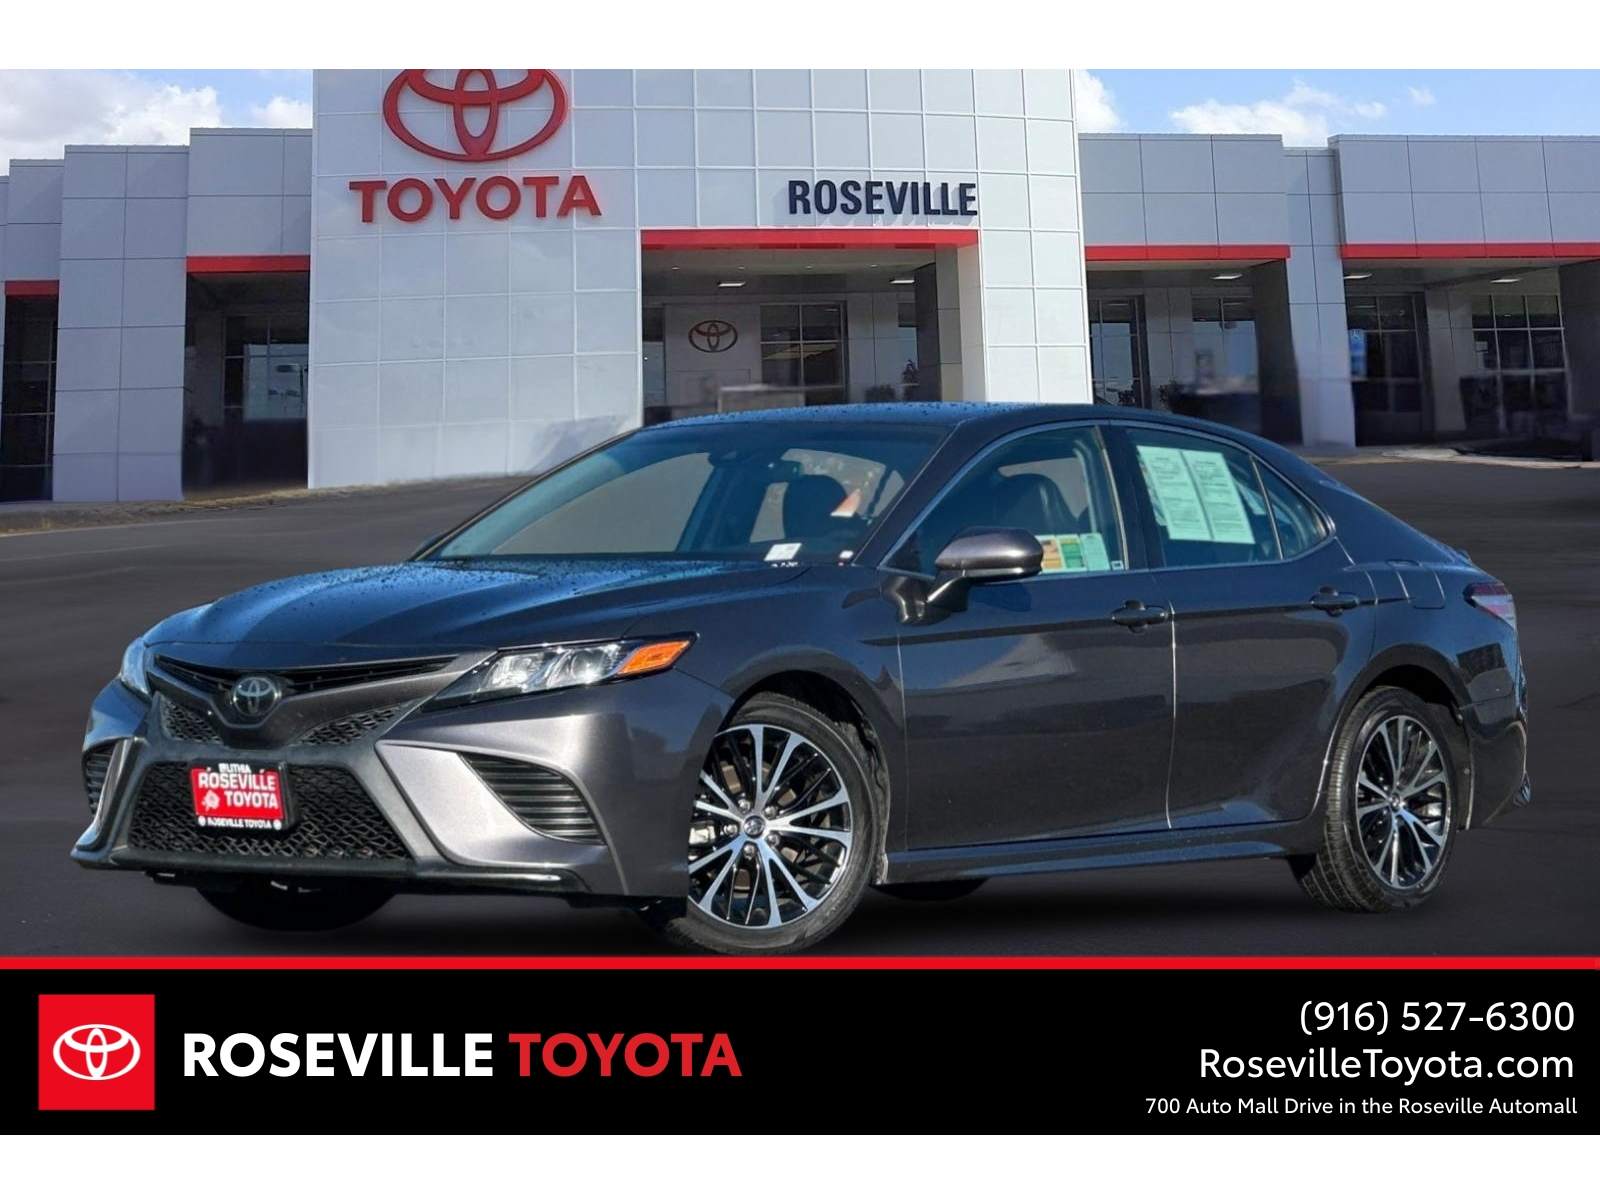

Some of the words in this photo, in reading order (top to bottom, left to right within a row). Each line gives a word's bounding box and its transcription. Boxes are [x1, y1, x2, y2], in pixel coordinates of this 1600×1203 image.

[349, 175, 602, 223] TOYOTA
[788, 179, 979, 217] ROSEVILLE
[198, 772, 276, 791] ROSEVILLE
[224, 791, 279, 809] TOYOTA
[207, 818, 244, 828] ROSEVILLE
[245, 819, 272, 830] TOYOTA
